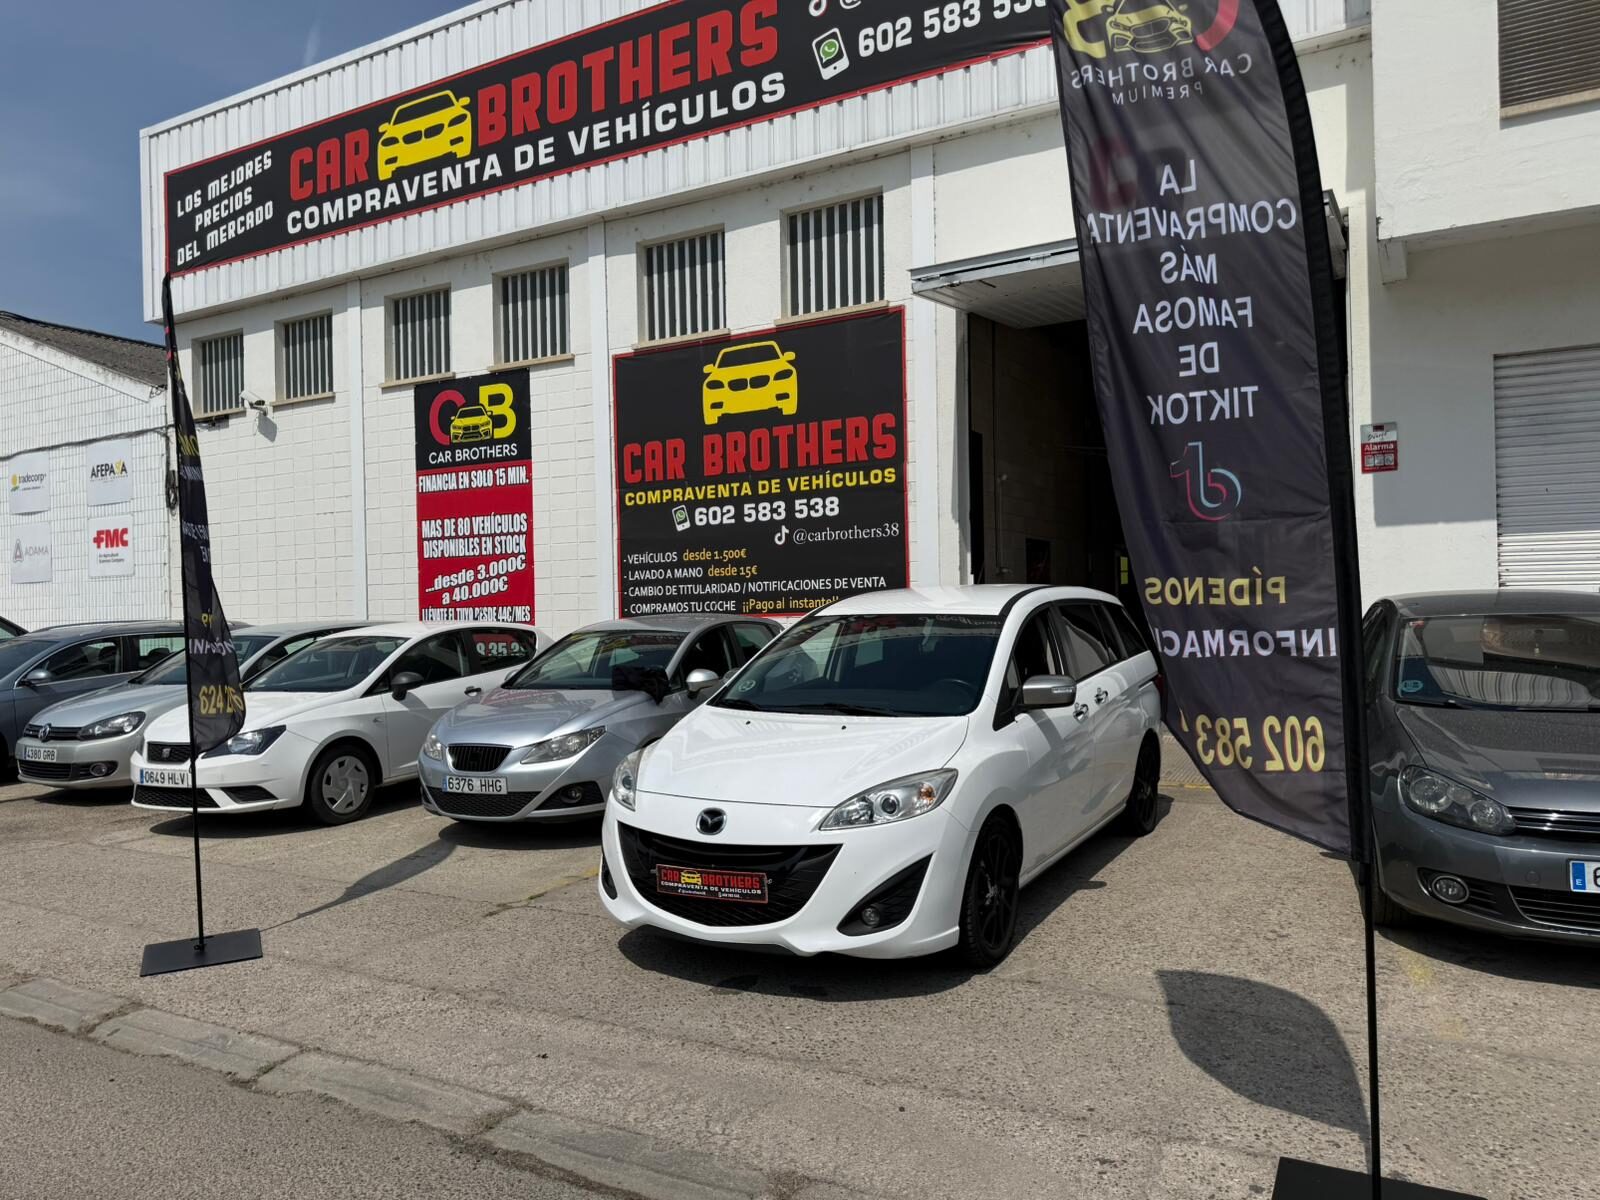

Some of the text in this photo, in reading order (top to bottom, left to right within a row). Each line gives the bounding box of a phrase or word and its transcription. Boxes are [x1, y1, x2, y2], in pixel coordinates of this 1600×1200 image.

[859, 16, 912, 58] 602
[923, 0, 981, 40] 583
[289, 0, 778, 201] CAR BROTHERS
[287, 72, 786, 235] COMPRAVENTA DE VEHÍCULOS
[177, 150, 273, 218] LOS MEJORES
[194, 186, 253, 233] PRECIOS
[177, 200, 274, 267] DEL MERCADO
[429, 443, 518, 465] CAR BROTHERS
[623, 412, 897, 484] CAR BROTHERS
[418, 465, 529, 492] FINANCIA EN SOLO 15 MIN.
[624, 467, 897, 506] COMPRAVENTA DE VEHÍCULOS
[694, 496, 840, 526] 602 583 538
[93, 527, 128, 549] FMC
[421, 512, 528, 538] MAS DE 80 VEHÍCULOS
[792, 522, 900, 545] @carbrothers38
[423, 534, 527, 559] DISPONIBLES EN STOCK
[628, 548, 747, 565] VEHÍCULOS desde 1.500€
[425, 554, 527, 592] ...desde 3.000€
[628, 565, 758, 581] LAVADO A MANO desde 15€
[441, 575, 509, 605] a 40.000€
[628, 585, 665, 598] CAMBIO
[665, 585, 678, 596] DE
[678, 582, 742, 596] TITULARIDAD
[748, 578, 832, 593] NOTIFICACIONES
[834, 578, 849, 590] DE
[850, 576, 886, 589] VENTA
[630, 601, 690, 615] COMPRAMOS
[690, 601, 703, 613] TU
[703, 600, 736, 613] COCHE
[776, 598, 785, 609] al
[199, 685, 224, 714] 624
[26, 748, 56, 761] 4380 GRB
[145, 771, 166, 784] 0649
[447, 777, 502, 792] 6376 HHG
[661, 869, 761, 889] CAR BROTHERS
[661, 880, 708, 890] COMPRAVENTA
[720, 887, 762, 895] VEHÍCULOS
